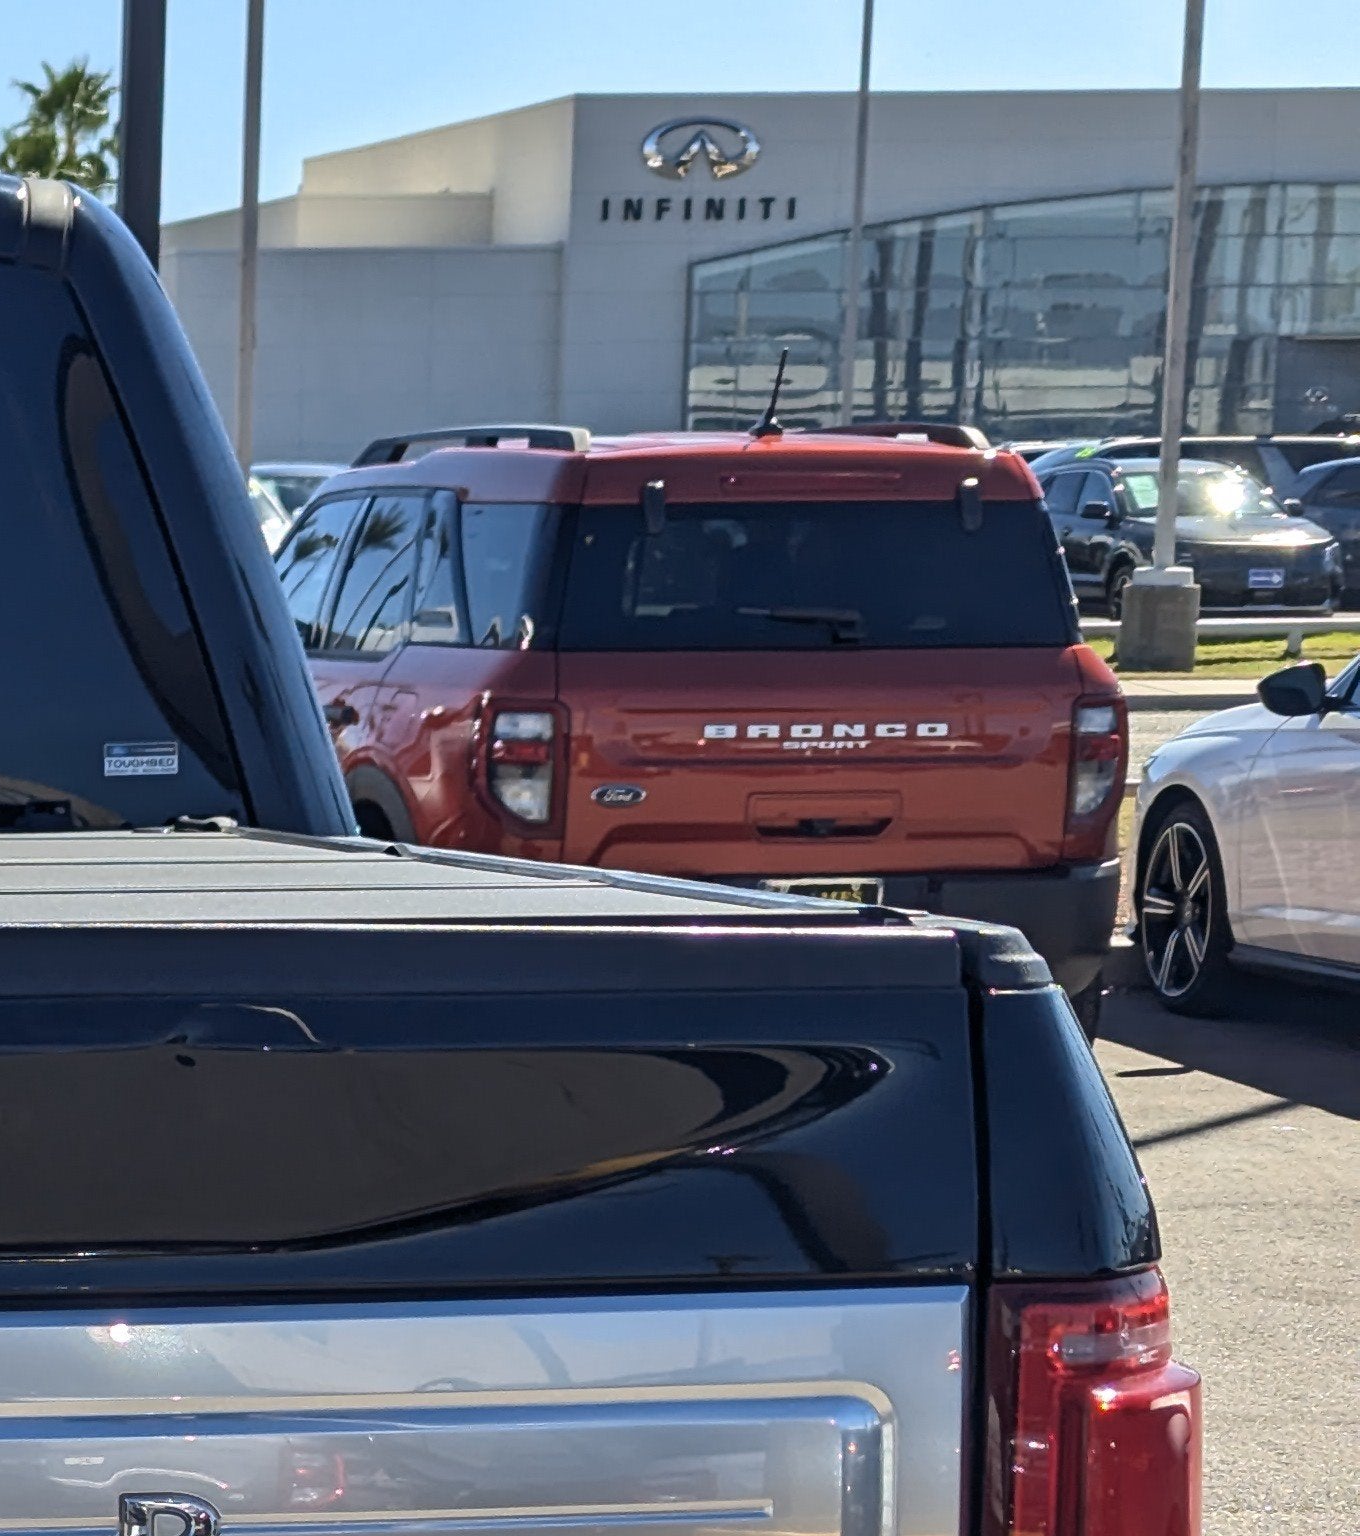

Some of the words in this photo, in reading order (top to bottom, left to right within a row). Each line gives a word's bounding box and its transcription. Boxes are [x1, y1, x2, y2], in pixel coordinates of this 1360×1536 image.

[601, 197, 797, 221] INFINITI
[703, 723, 949, 739] BRONCO
[782, 740, 872, 750] SPORT
